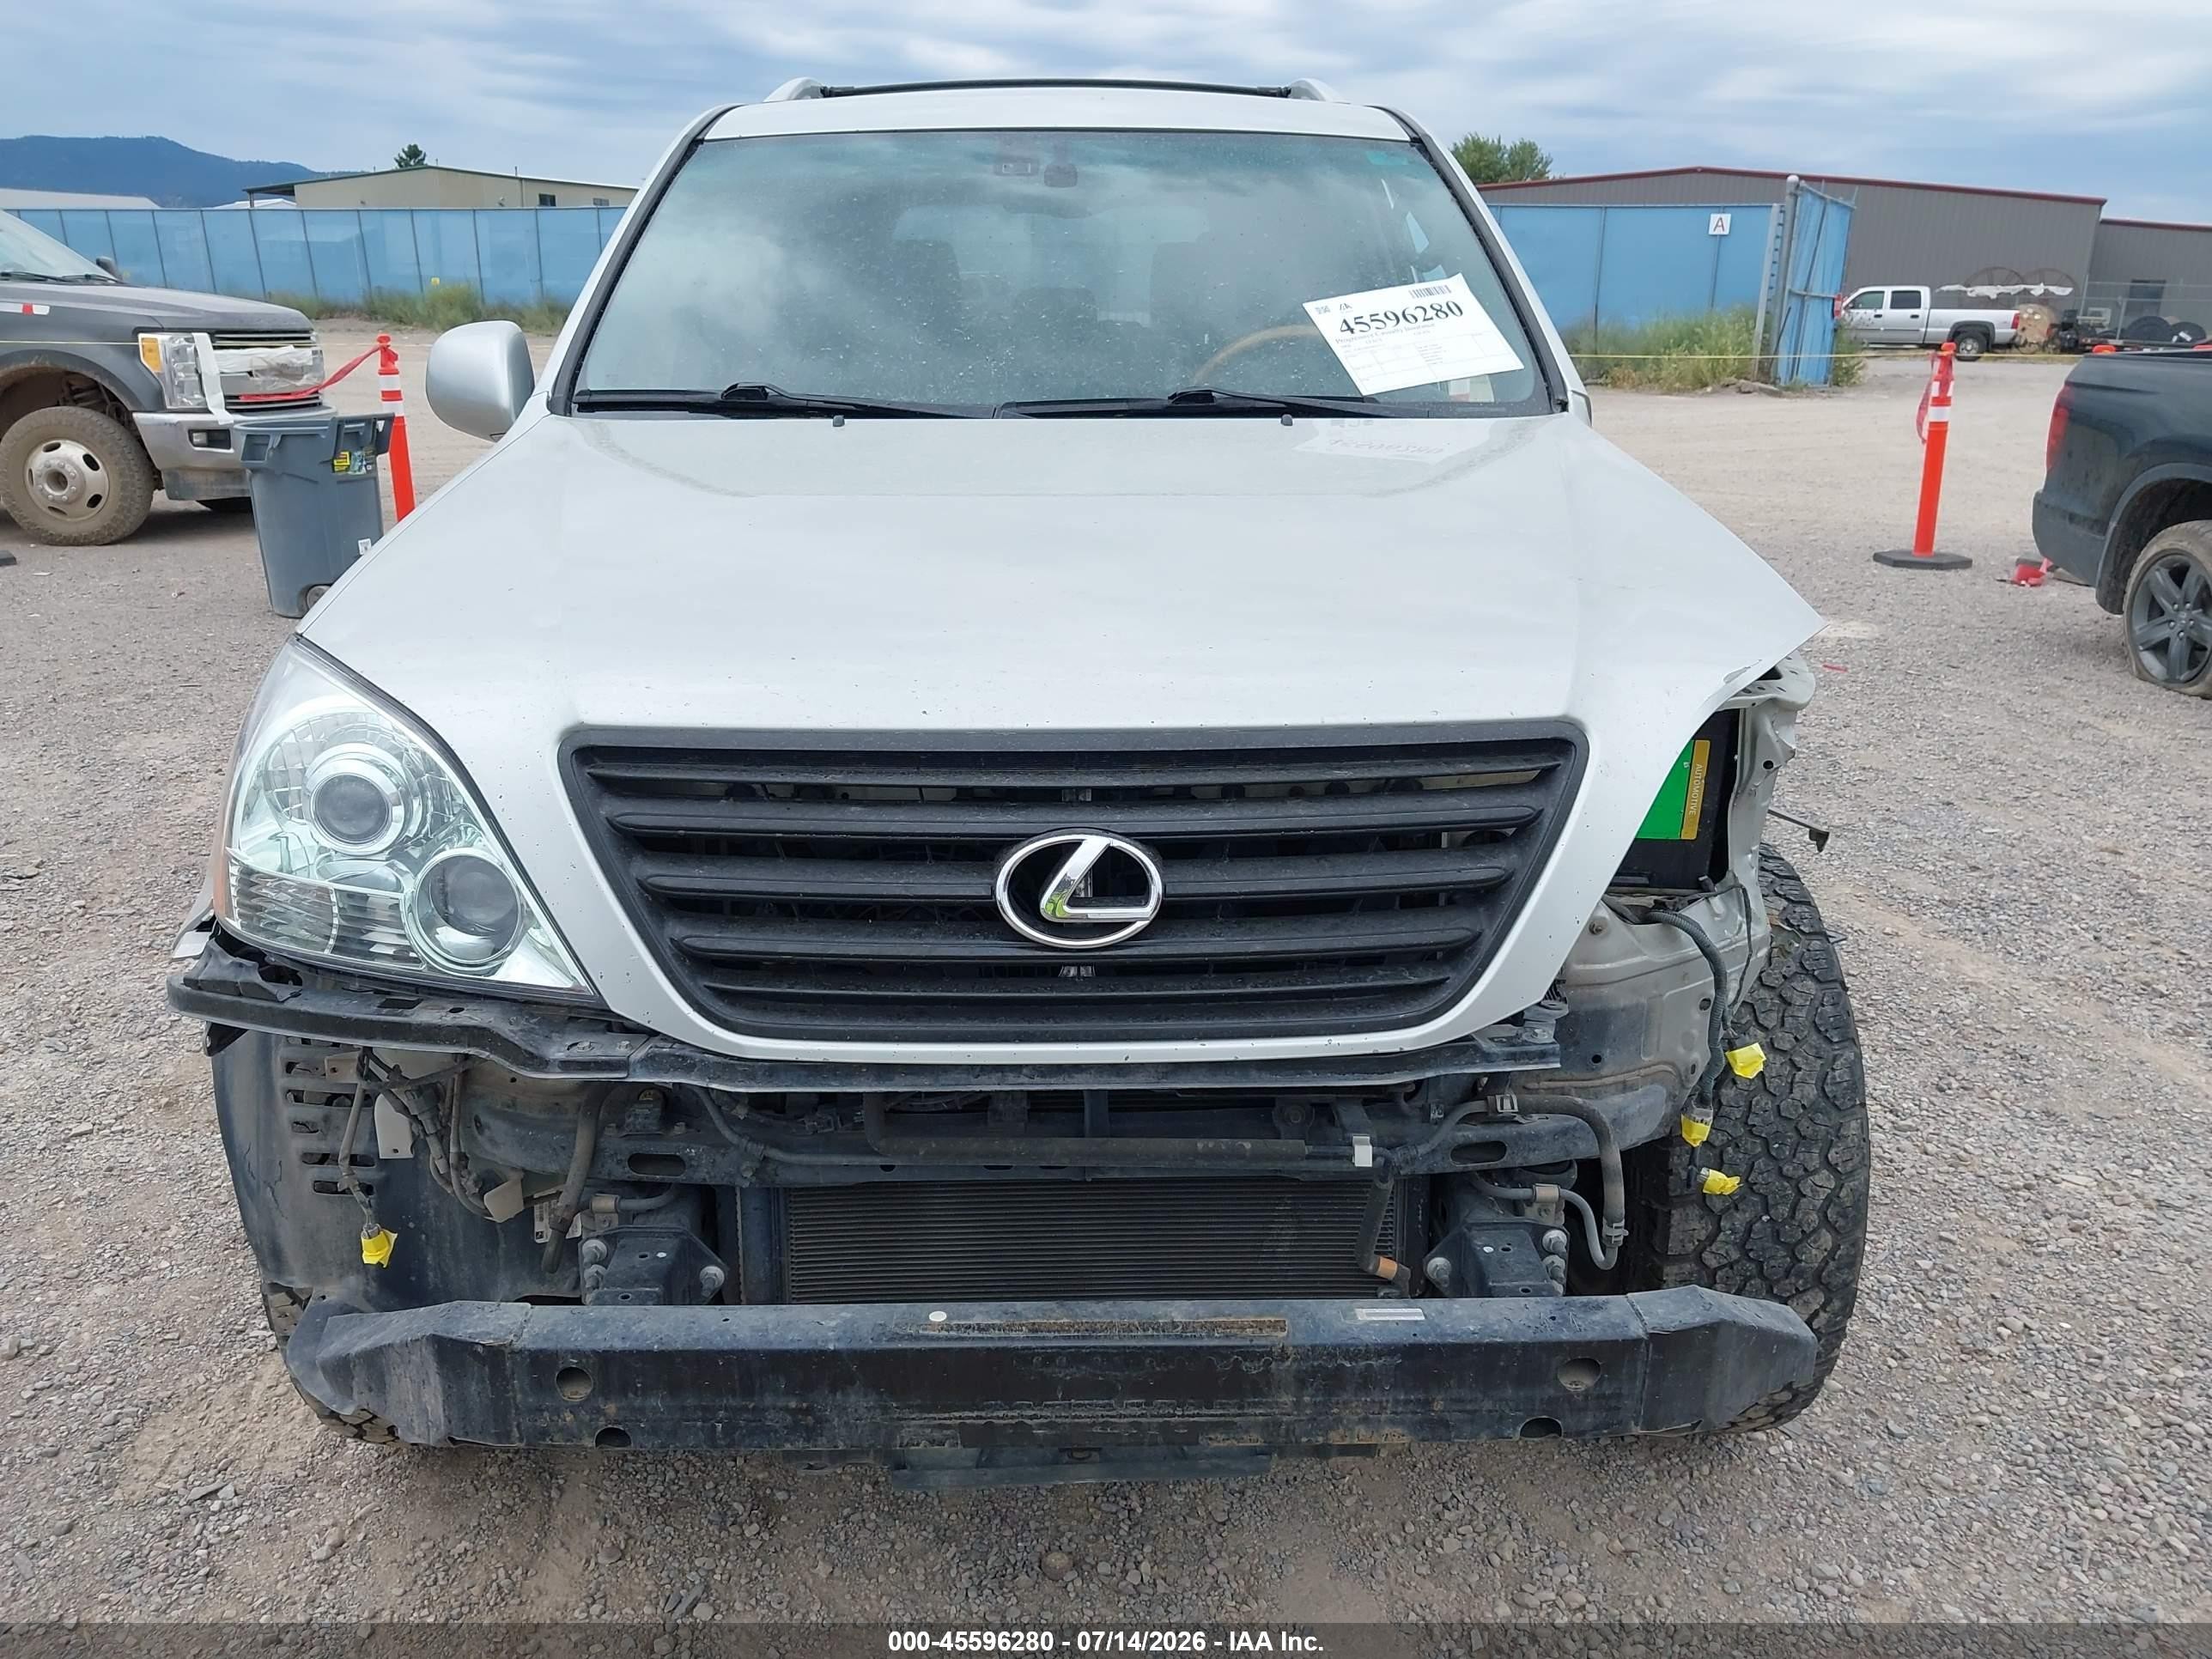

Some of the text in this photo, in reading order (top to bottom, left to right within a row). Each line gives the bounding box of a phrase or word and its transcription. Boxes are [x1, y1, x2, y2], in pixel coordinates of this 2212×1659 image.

[1713, 216, 1725, 232] A
[1340, 300, 1463, 334] 45596280
[1688, 763, 1704, 816] AUTOMOTIVE
